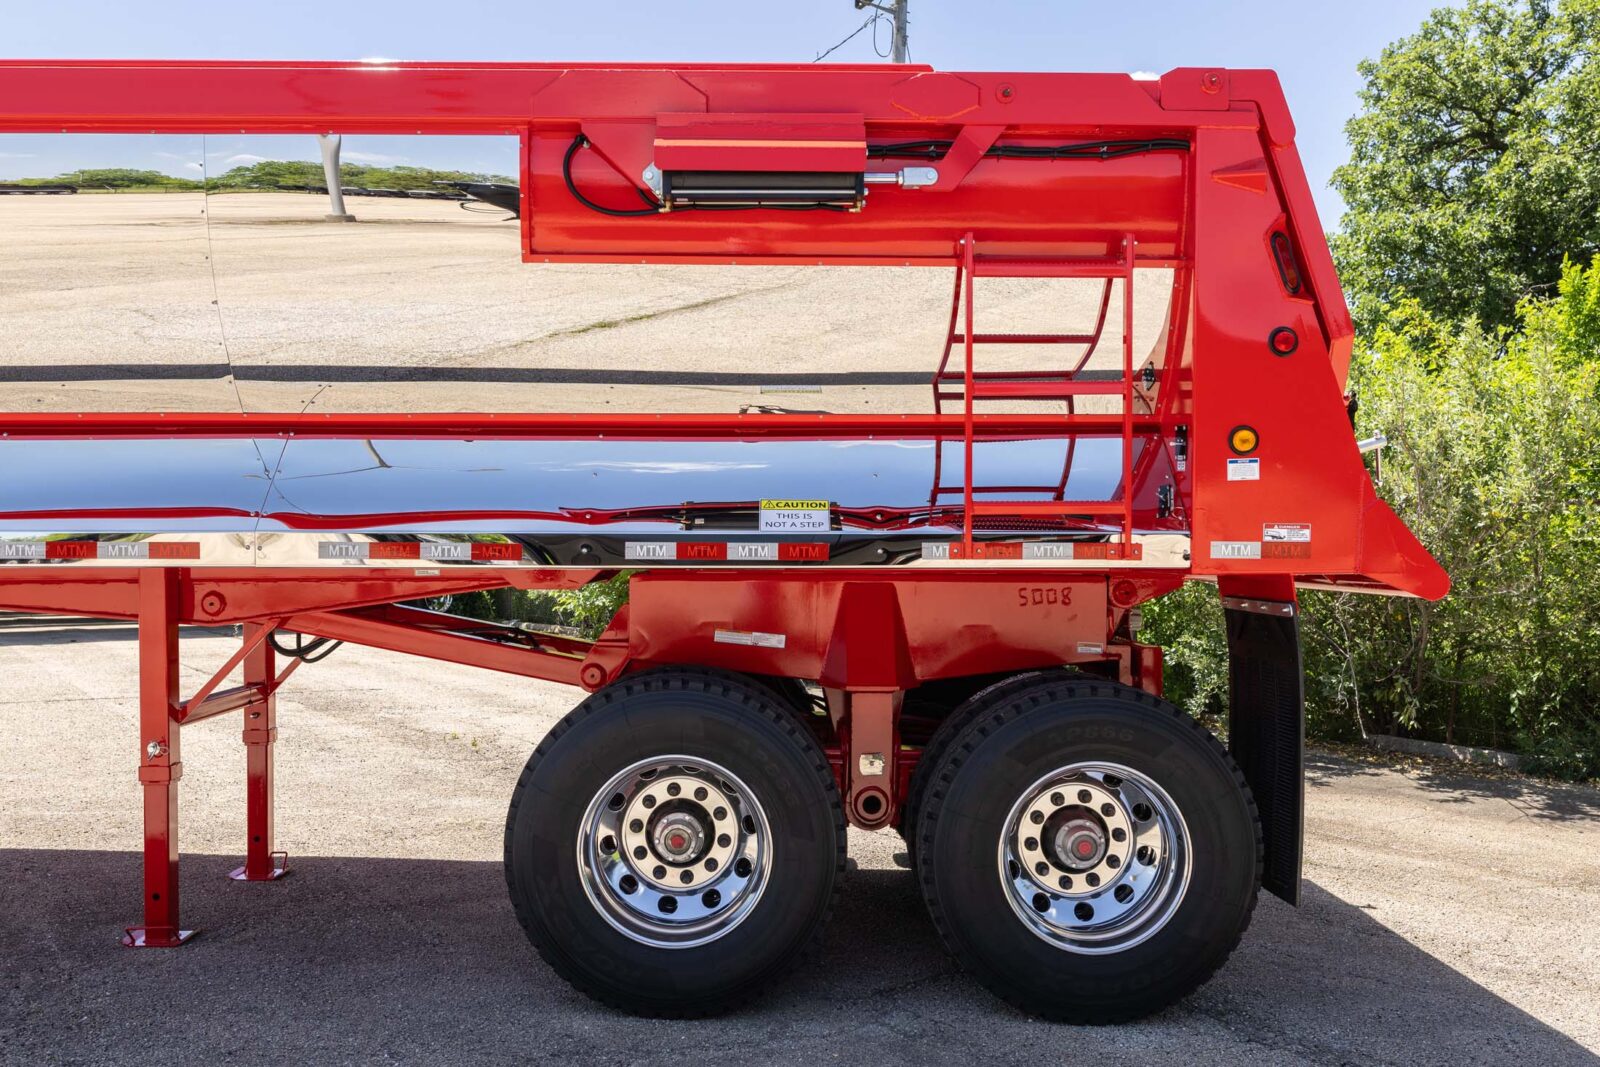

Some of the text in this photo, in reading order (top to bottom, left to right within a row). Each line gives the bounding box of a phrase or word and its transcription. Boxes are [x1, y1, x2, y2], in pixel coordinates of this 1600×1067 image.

[5, 544, 190, 557] MTM MTM MTM MTM
[328, 544, 512, 558] MTM MTM MTM MTM
[636, 545, 819, 558] MTM MTM MTM MTM
[932, 545, 949, 557] MT
[1033, 545, 1064, 557] MTM
[1084, 546, 1106, 557] MT
[1221, 544, 1301, 557] MTM MTM
